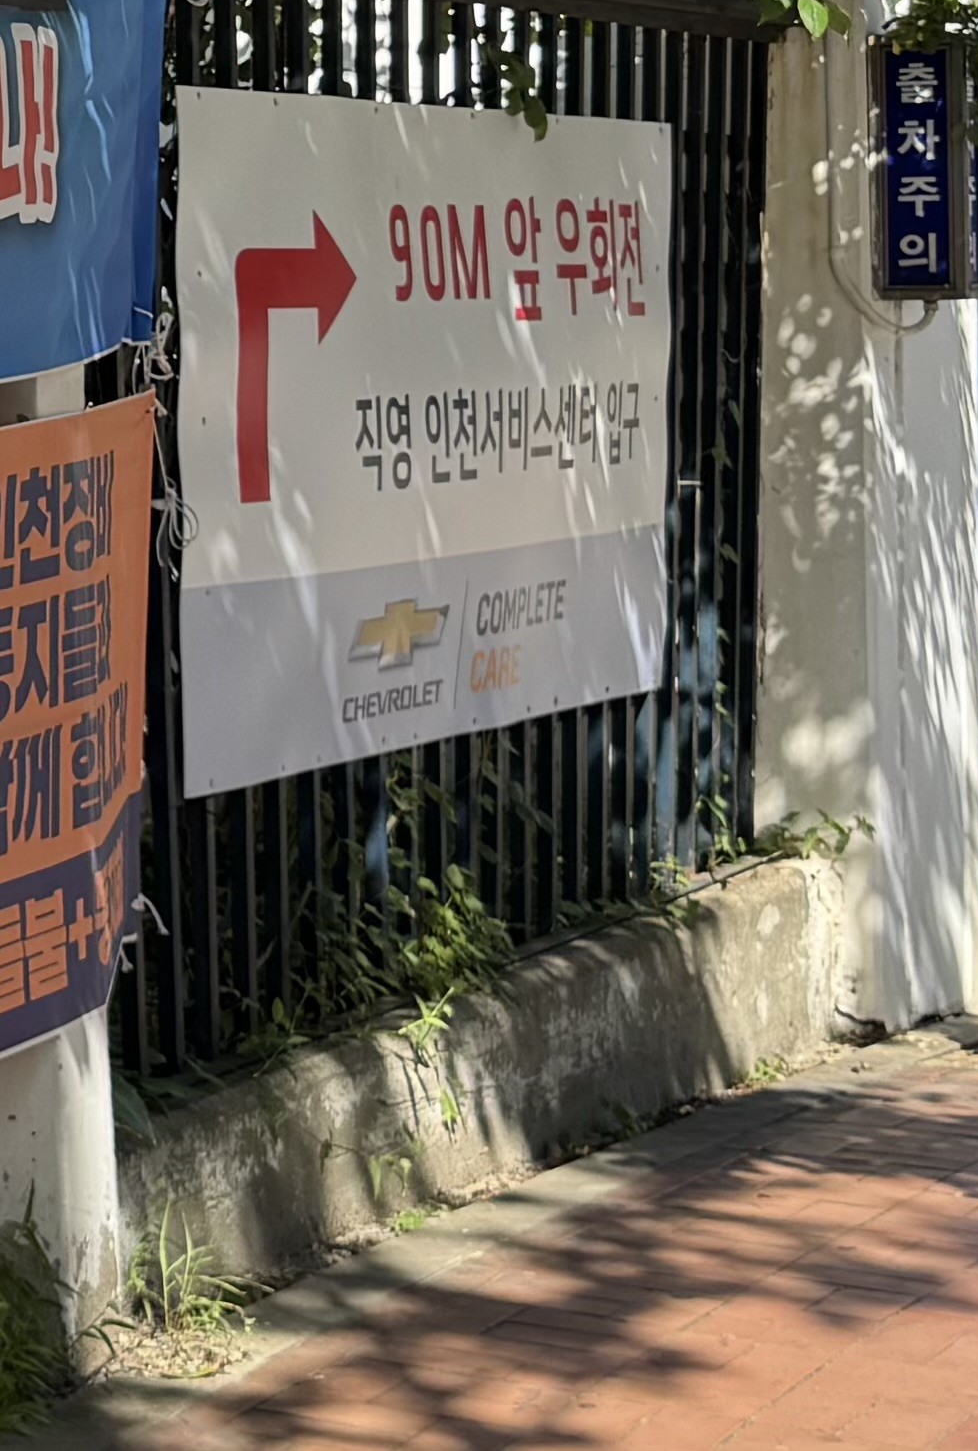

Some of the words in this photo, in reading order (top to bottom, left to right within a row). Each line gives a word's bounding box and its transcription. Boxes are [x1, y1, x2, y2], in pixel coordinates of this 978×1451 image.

[895, 62, 940, 273] 출차주의
[388, 204, 491, 302] 90M
[504, 196, 542, 321] 앞
[555, 197, 645, 316] 우회전
[355, 394, 412, 491] 직영
[425, 387, 598, 481] 인천서비스센터
[606, 381, 640, 465] 입구
[476, 579, 566, 636] COMPLETE
[342, 679, 443, 723] CHEVROLET
[470, 644, 521, 693] CARE
